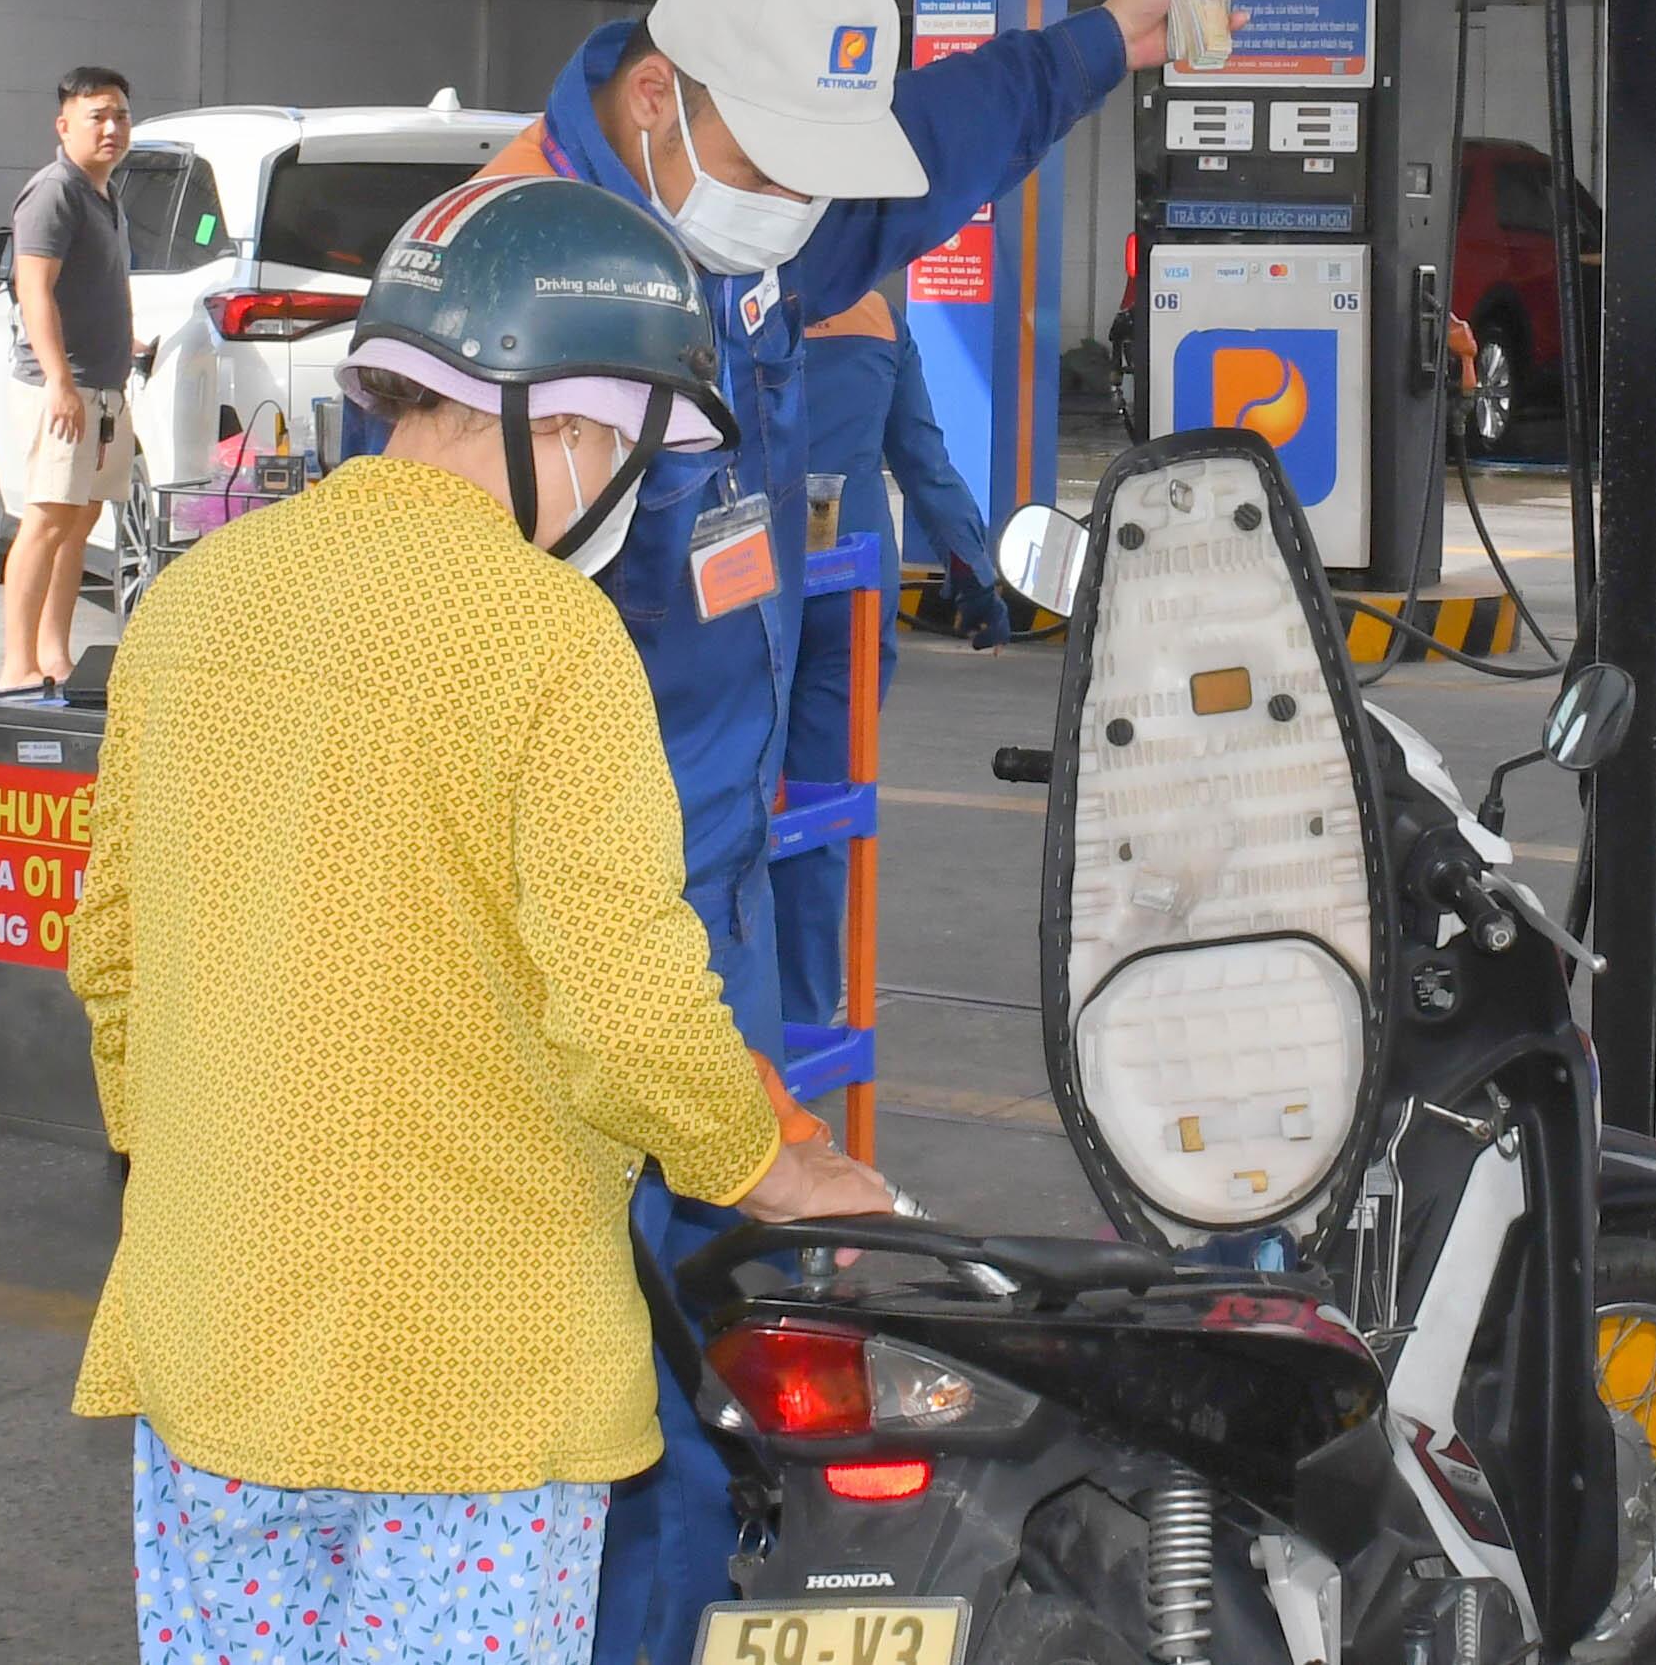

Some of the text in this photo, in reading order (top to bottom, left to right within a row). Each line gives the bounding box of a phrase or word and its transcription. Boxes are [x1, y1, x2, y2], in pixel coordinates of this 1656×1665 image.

[1200, 209, 1216, 224] SỐ
[1298, 214, 1317, 226] KHI
[1163, 267, 1190, 278] VISA
[535, 277, 583, 293] Driving
[1154, 293, 1179, 309] 06
[1333, 294, 1358, 310] 05
[23, 856, 62, 899] 01
[805, 1572, 895, 1589] HONDA
